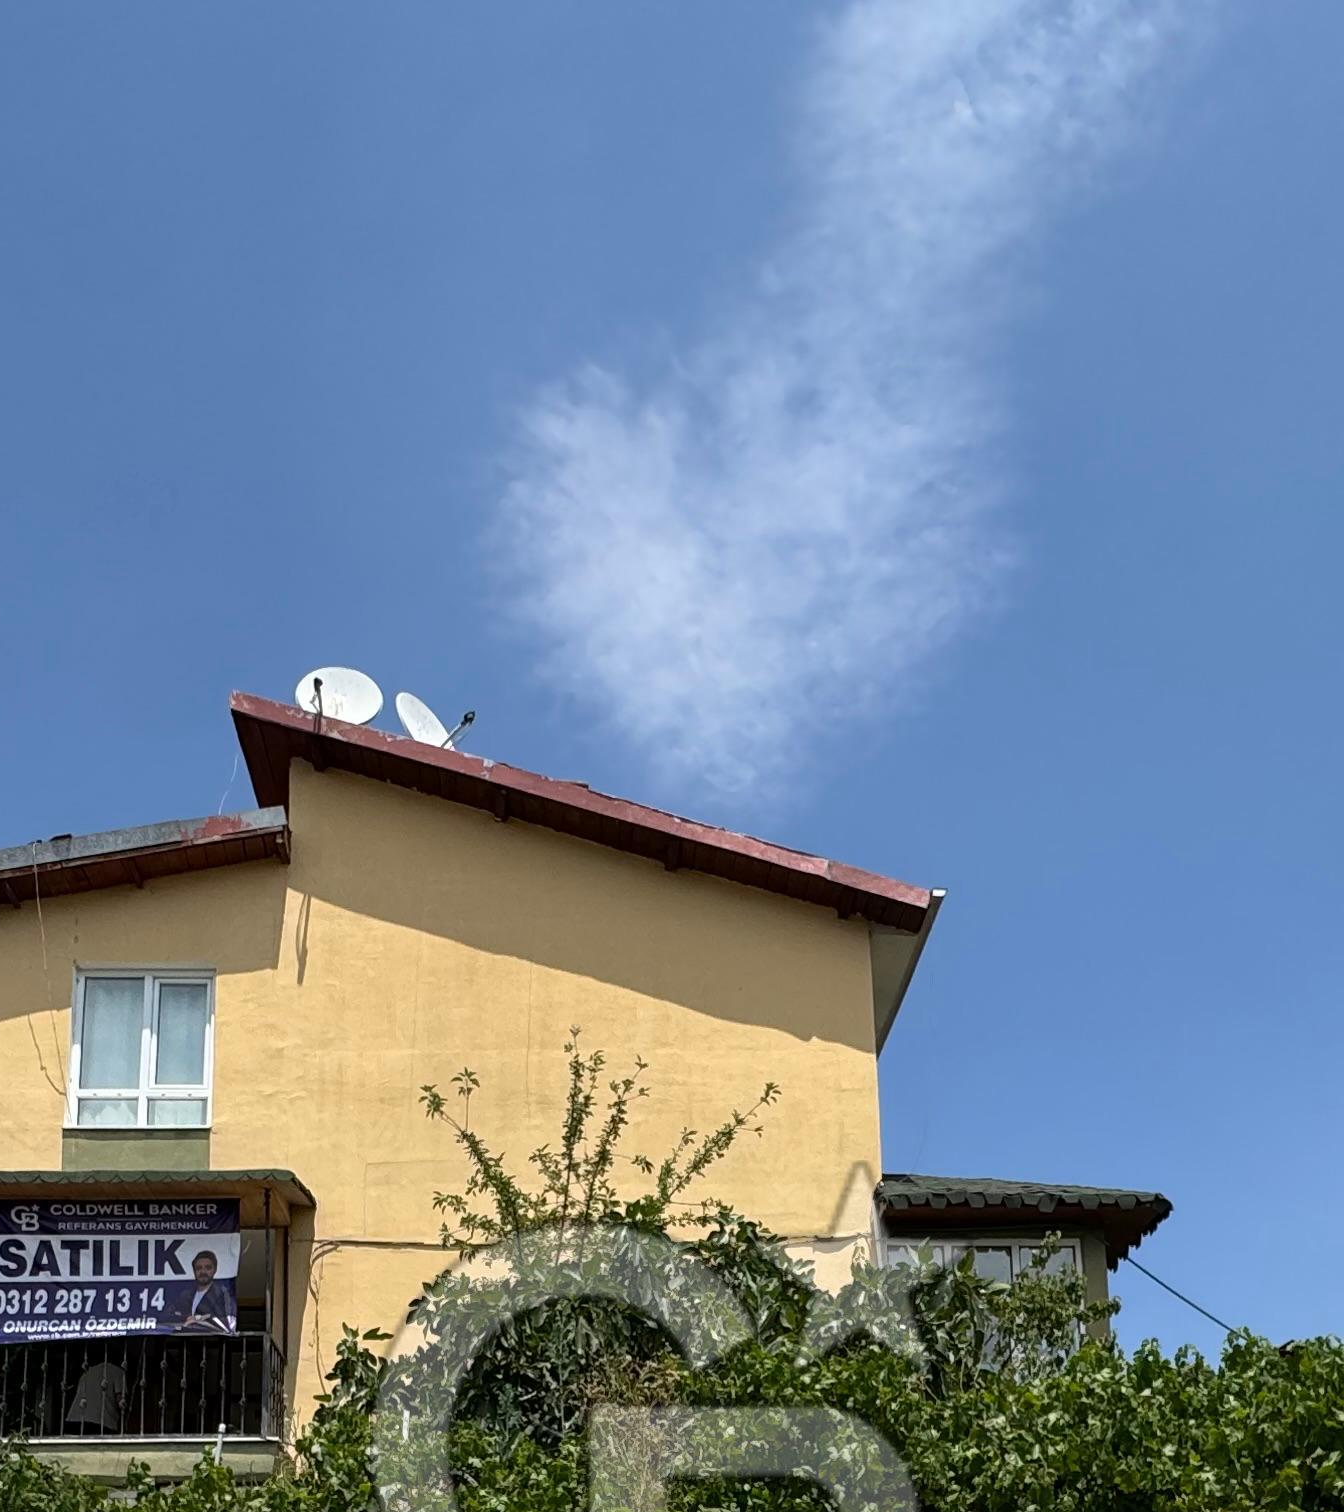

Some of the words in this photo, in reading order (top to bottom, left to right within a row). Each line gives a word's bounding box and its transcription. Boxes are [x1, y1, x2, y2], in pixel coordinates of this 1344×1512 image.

[50, 1204, 144, 1216] COLDWELL
[149, 1203, 217, 1215] BANKER
[58, 1222, 121, 1231] REFERANS
[54, 1289, 97, 1314] 287
[105, 1288, 131, 1313] 13
[139, 1287, 165, 1312] 14
[3, 1319, 81, 1334] ONURCAN
[85, 1314, 157, 1331] ÖZDEMİR
